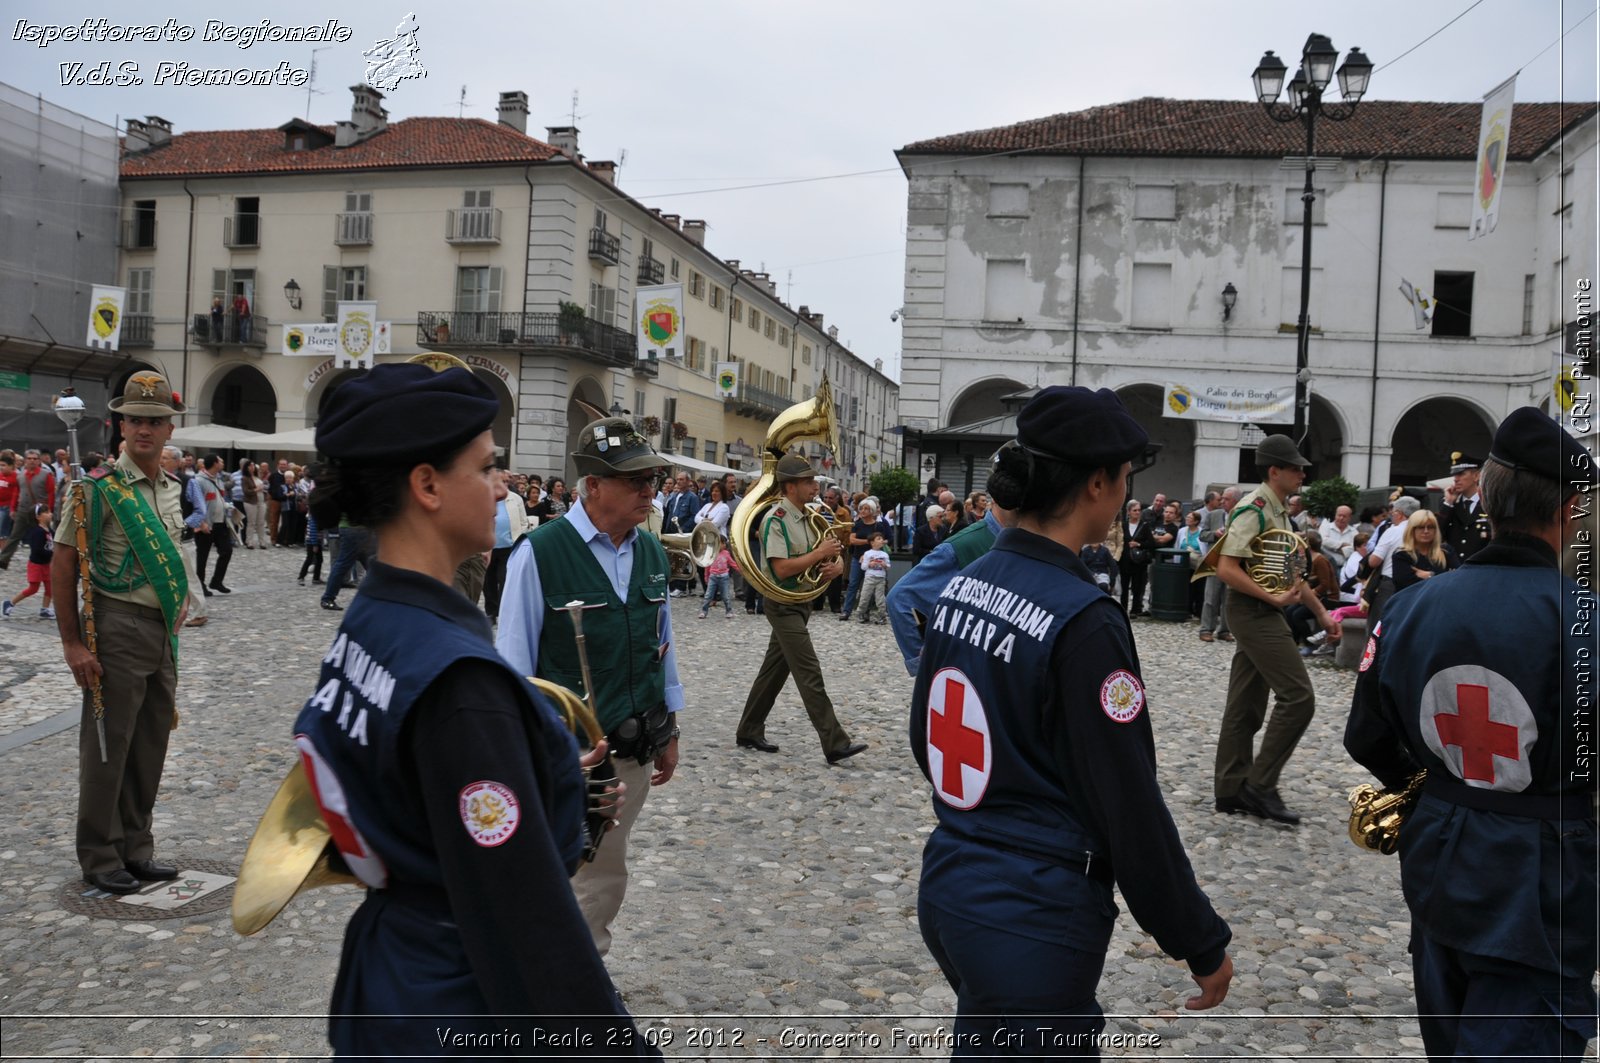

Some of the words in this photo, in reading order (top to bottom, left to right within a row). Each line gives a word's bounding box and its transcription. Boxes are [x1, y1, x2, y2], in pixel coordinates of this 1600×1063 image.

[466, 355, 510, 381] CERNAIA
[1206, 387, 1229, 398] Palio
[1231, 390, 1245, 399] dei
[1247, 390, 1278, 401] Borghi
[1196, 398, 1226, 412] Borgo
[1112, 701, 1140, 719] FANFARA
